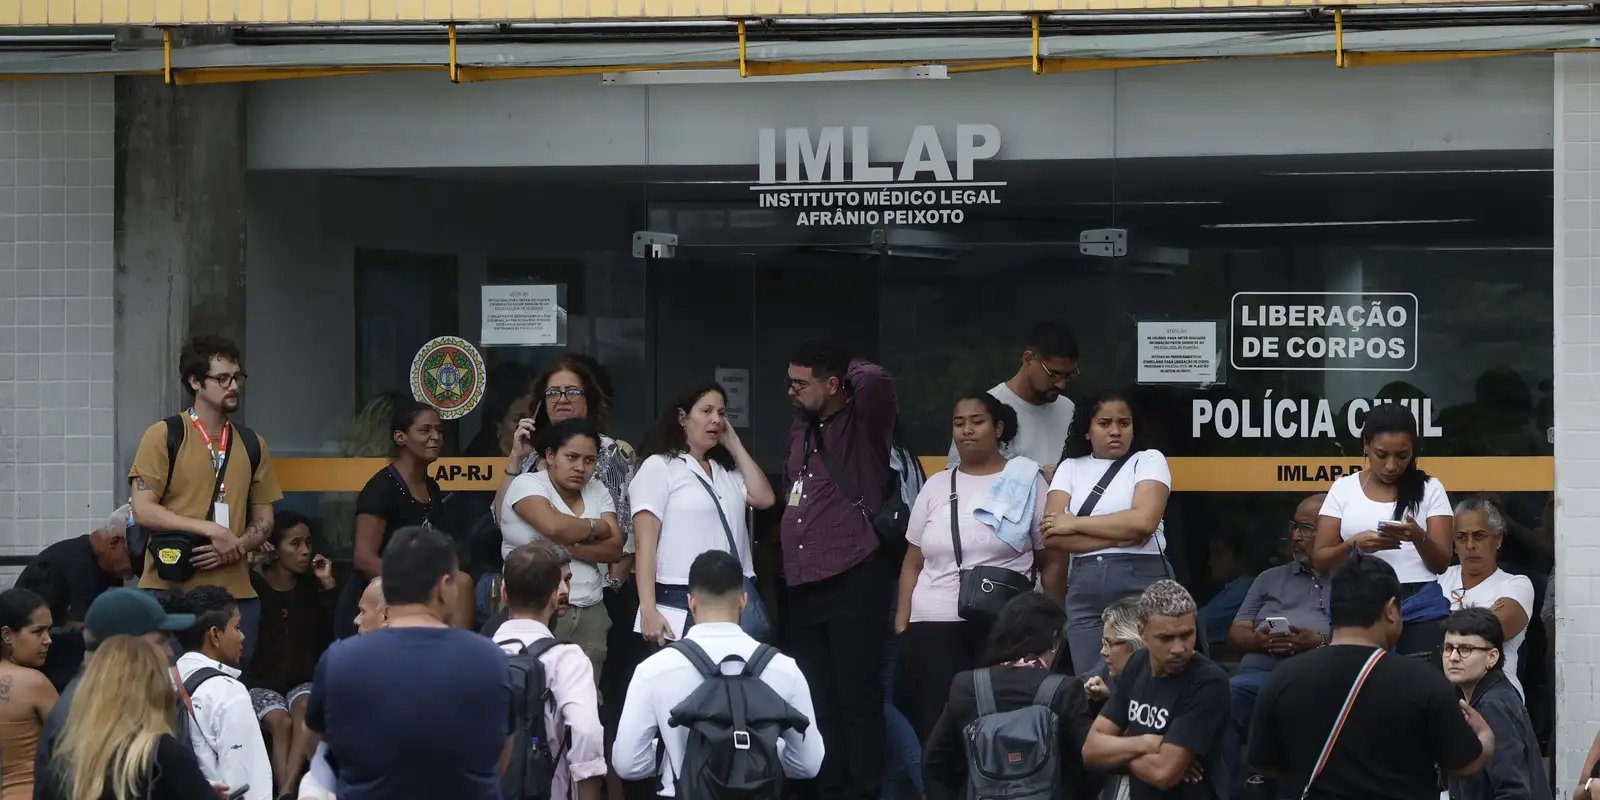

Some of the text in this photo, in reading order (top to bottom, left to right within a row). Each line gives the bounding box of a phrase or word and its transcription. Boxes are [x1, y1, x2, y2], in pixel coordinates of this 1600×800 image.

[758, 124, 1001, 183] IMLAP
[759, 188, 1001, 208] INSTITUTO MÉDICO LEGAL
[796, 208, 964, 226] AFRÂNIO PEIXOTO
[1241, 301, 1407, 331] LIBERAÇÃO
[1242, 336, 1406, 360] DE CORPOS
[1192, 389, 1443, 438] POLÍCIA CIL
[435, 465, 493, 481] AP-RJ
[1128, 699, 1169, 729] BOSS
